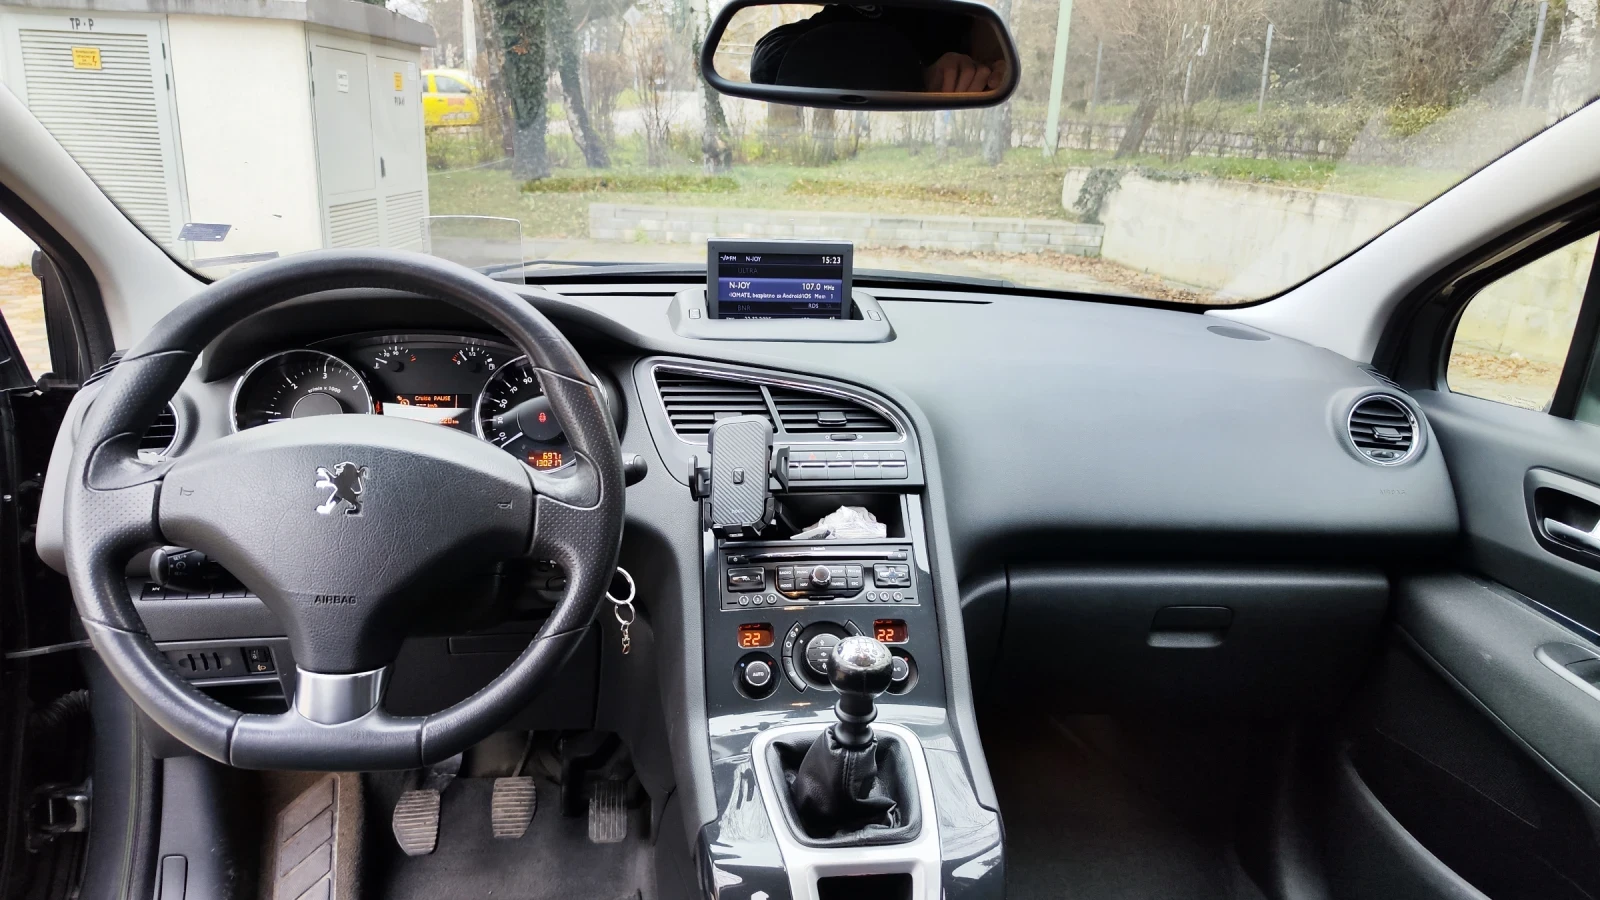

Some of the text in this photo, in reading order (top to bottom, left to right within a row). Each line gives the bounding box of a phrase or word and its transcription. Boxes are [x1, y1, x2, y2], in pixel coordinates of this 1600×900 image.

[821, 256, 841, 264] 15:23
[728, 281, 751, 290] N-JOY
[802, 282, 821, 291] 107.0
[737, 304, 751, 312] BNR
[322, 372, 328, 380] 3
[522, 376, 533, 385] 90
[328, 386, 341, 394] 1000
[509, 386, 518, 394] 70
[499, 398, 508, 409] 50
[497, 416, 504, 424] 30
[498, 431, 507, 441] 10
[535, 459, 562, 467] 130217
[314, 595, 357, 604] AIRBAG
[743, 633, 761, 646] 22
[877, 629, 894, 642] 22
